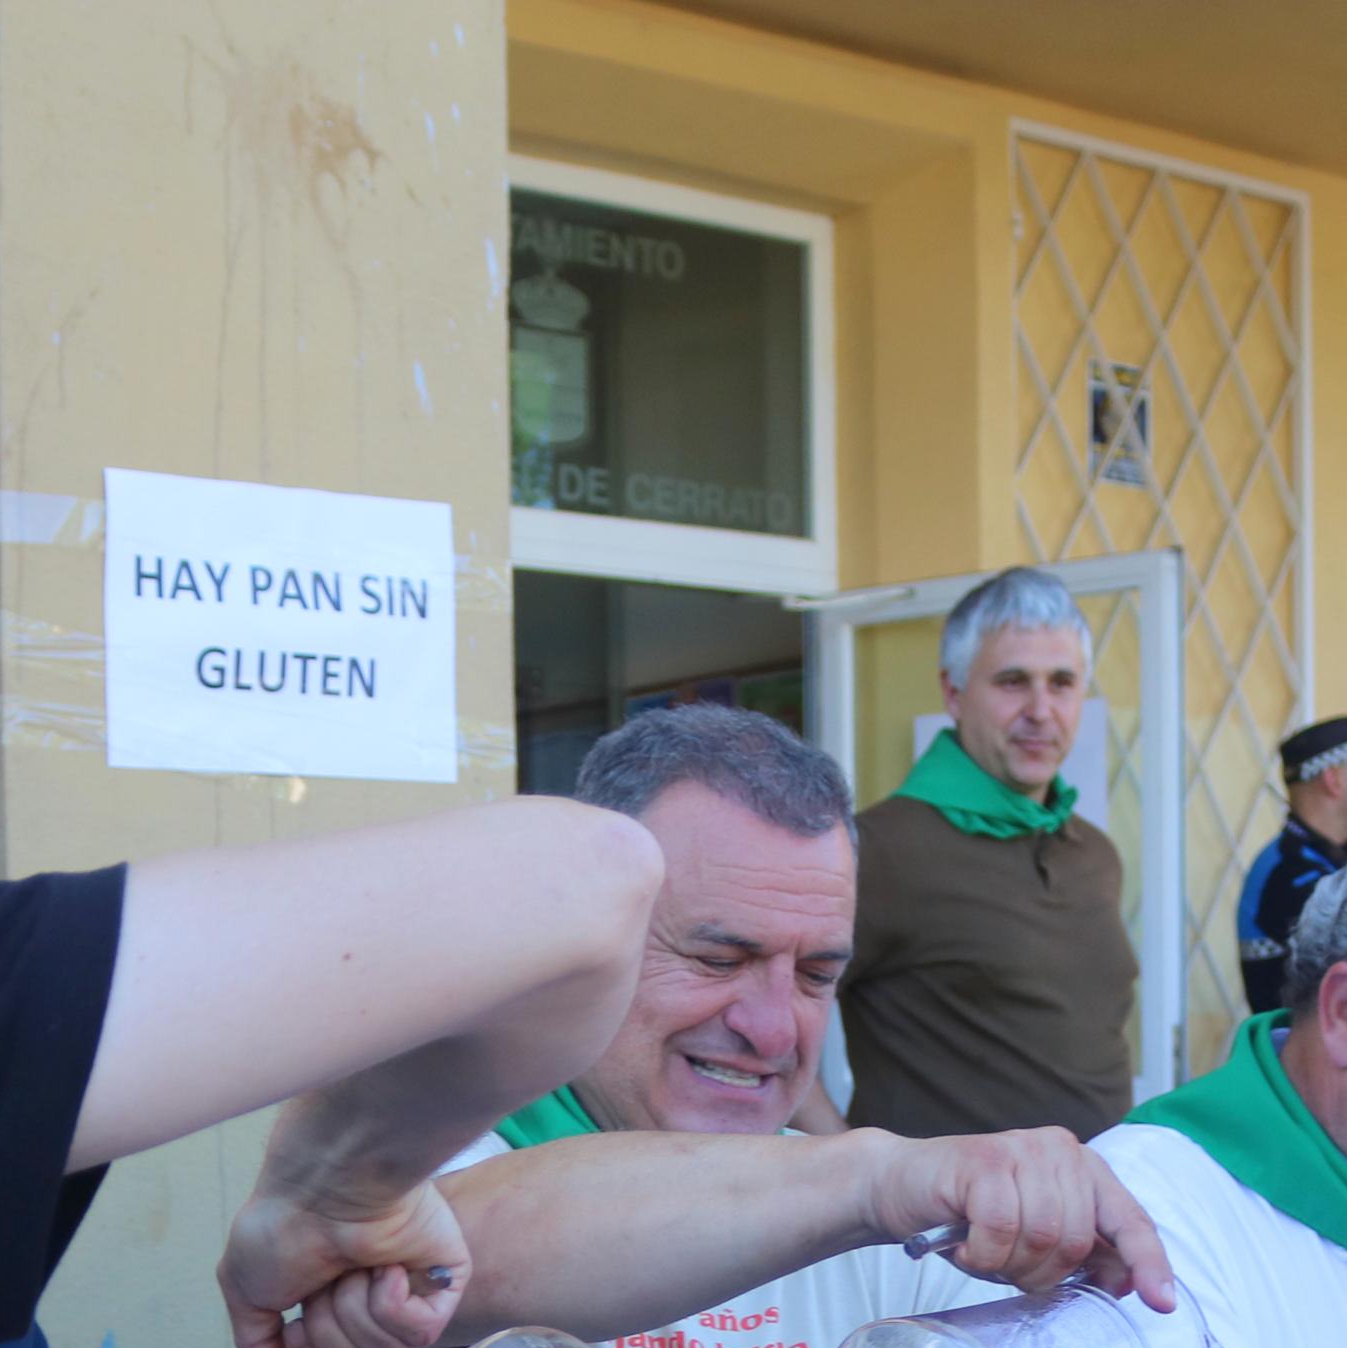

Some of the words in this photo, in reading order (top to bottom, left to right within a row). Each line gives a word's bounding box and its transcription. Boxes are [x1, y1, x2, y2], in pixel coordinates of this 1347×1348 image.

[556, 463, 610, 505] DE
[624, 473, 794, 529] CERRATO
[134, 555, 230, 602] HAY
[249, 564, 342, 612] PAN
[360, 574, 428, 619] SIN
[195, 647, 376, 698] GLUTEN
[699, 1306, 780, 1331] años
